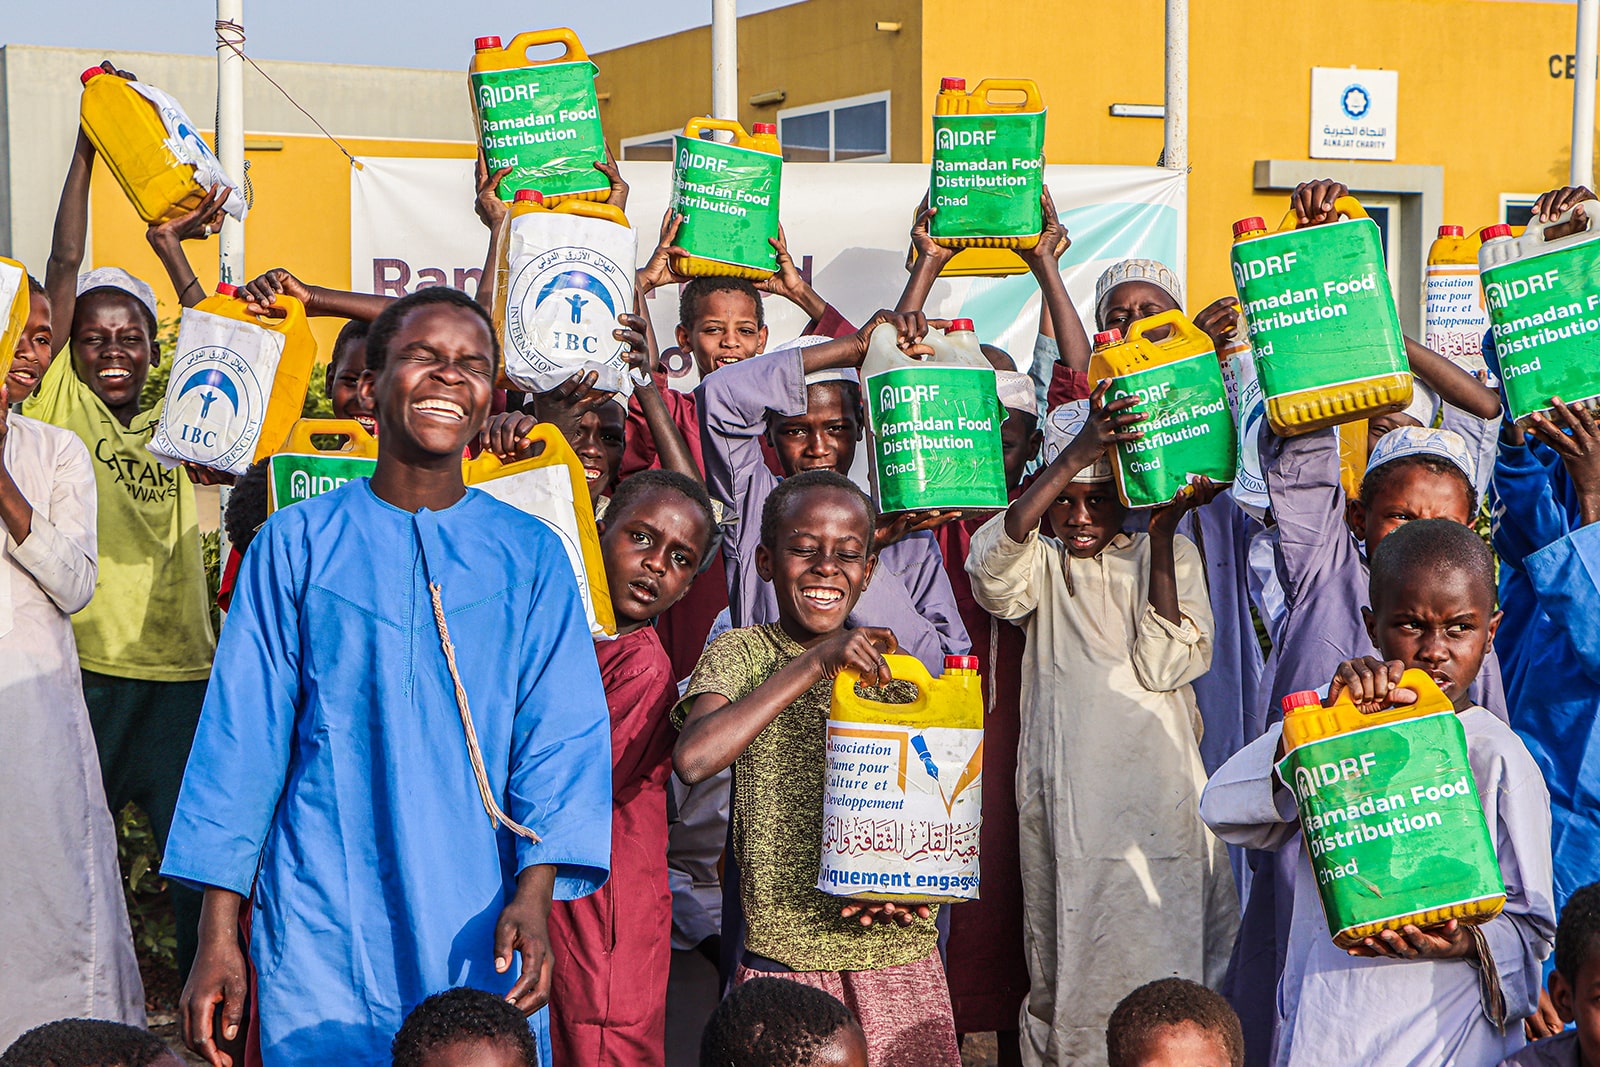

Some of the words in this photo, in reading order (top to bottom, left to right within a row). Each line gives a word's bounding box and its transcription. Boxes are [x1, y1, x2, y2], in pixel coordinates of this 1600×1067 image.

[1549, 54, 1576, 80] CE
[496, 83, 540, 104] IDRF
[482, 112, 555, 132] Ramadan
[559, 106, 597, 123] Food
[485, 128, 577, 150] Distribution
[954, 130, 996, 146] IDRF
[1356, 140, 1386, 149] CHARITY
[489, 154, 518, 169] Chad
[689, 153, 728, 173] IDRF
[936, 158, 1007, 172] Ramadan
[936, 174, 1027, 188] Distribution
[736, 189, 770, 207] Food
[936, 195, 968, 206] Chad
[1243, 252, 1297, 281] IDRF
[1244, 287, 1318, 316] amadan
[1323, 274, 1376, 298] Food
[1504, 269, 1559, 301] IDRF
[1427, 303, 1457, 313] ulture
[1461, 305, 1472, 313] et
[1449, 293, 1472, 303] pour
[1493, 302, 1583, 339] Ramadan
[552, 331, 598, 354] IBC
[1497, 318, 1600, 358] Distributio
[1504, 356, 1541, 380] Chad
[896, 385, 940, 404] IDRF
[1191, 397, 1225, 419] Food
[181, 423, 217, 448] IBC
[882, 417, 953, 437] Ramadan
[958, 417, 992, 431] Food
[883, 435, 974, 456] Distribution
[1125, 422, 1210, 454] Distribution
[885, 459, 917, 477] Chad
[1130, 457, 1161, 473] Chad
[857, 762, 889, 776] pour
[1311, 752, 1377, 788] IDRF
[874, 780, 888, 791] et
[1305, 792, 1406, 835] Ramadan
[1411, 776, 1470, 805] Food
[1311, 811, 1442, 858] Distribution
[1319, 858, 1359, 886] Chad
